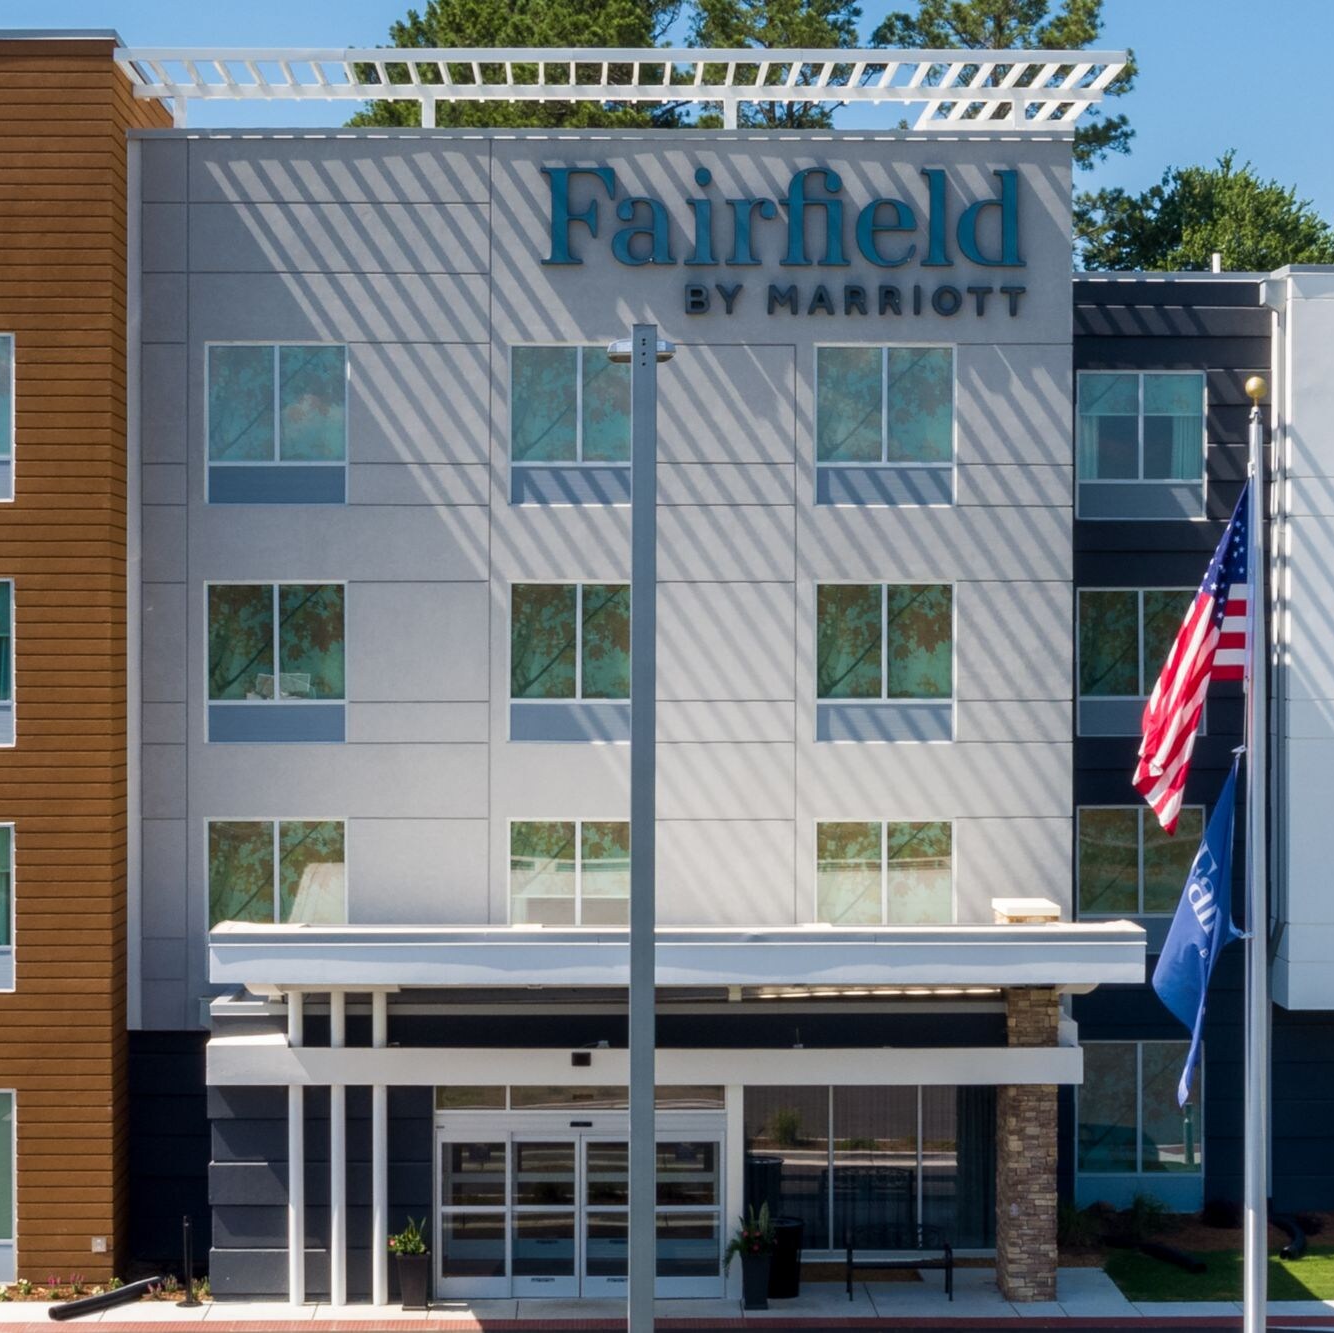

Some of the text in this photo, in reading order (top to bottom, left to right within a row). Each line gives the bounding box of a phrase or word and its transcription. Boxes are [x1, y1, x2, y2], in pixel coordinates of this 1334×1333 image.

[540, 166, 1028, 267] Fairfield
[684, 283, 1027, 317] BY MARRIOTT
